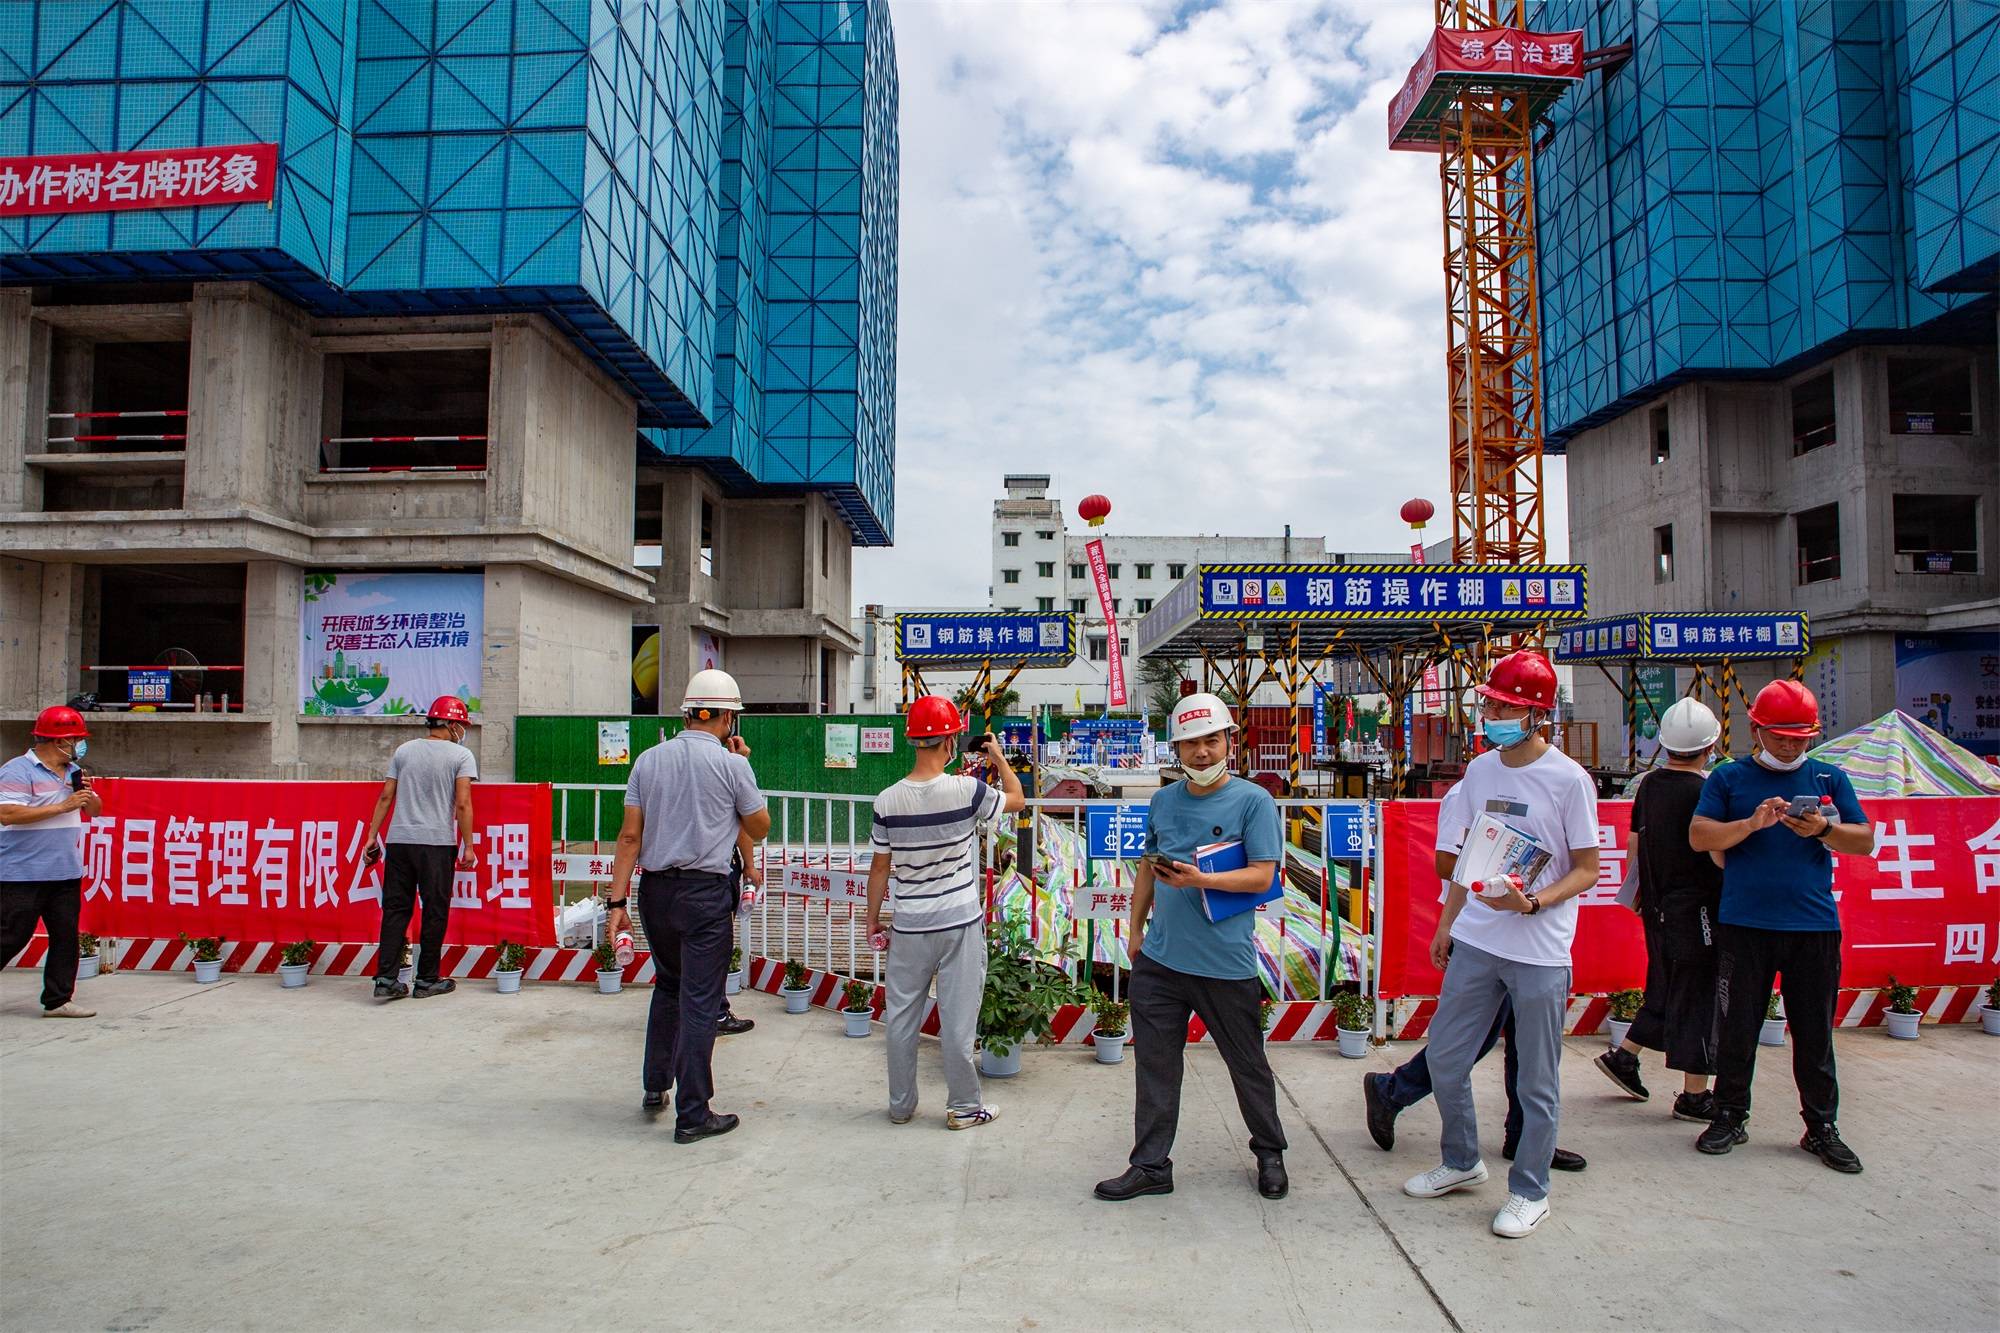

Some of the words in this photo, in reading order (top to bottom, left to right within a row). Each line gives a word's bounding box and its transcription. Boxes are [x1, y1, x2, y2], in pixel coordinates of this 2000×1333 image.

[1460, 38, 1575, 65] 综合治理
[1306, 578, 1485, 606] 钢筋操作棚
[322, 612, 466, 633] 开展城乡环境整治
[326, 631, 470, 651] 改善生态人居环境
[937, 627, 1034, 644] 钢筋操作棚
[1683, 626, 1771, 643] 钢筋操作棚
[864, 731, 890, 739] 施工区域
[864, 741, 890, 749] 注意安全
[80, 815, 532, 909] 项目管理有限公监理
[791, 871, 831, 892] 严禁抛物
[1700, 905, 1712, 946] adidas
